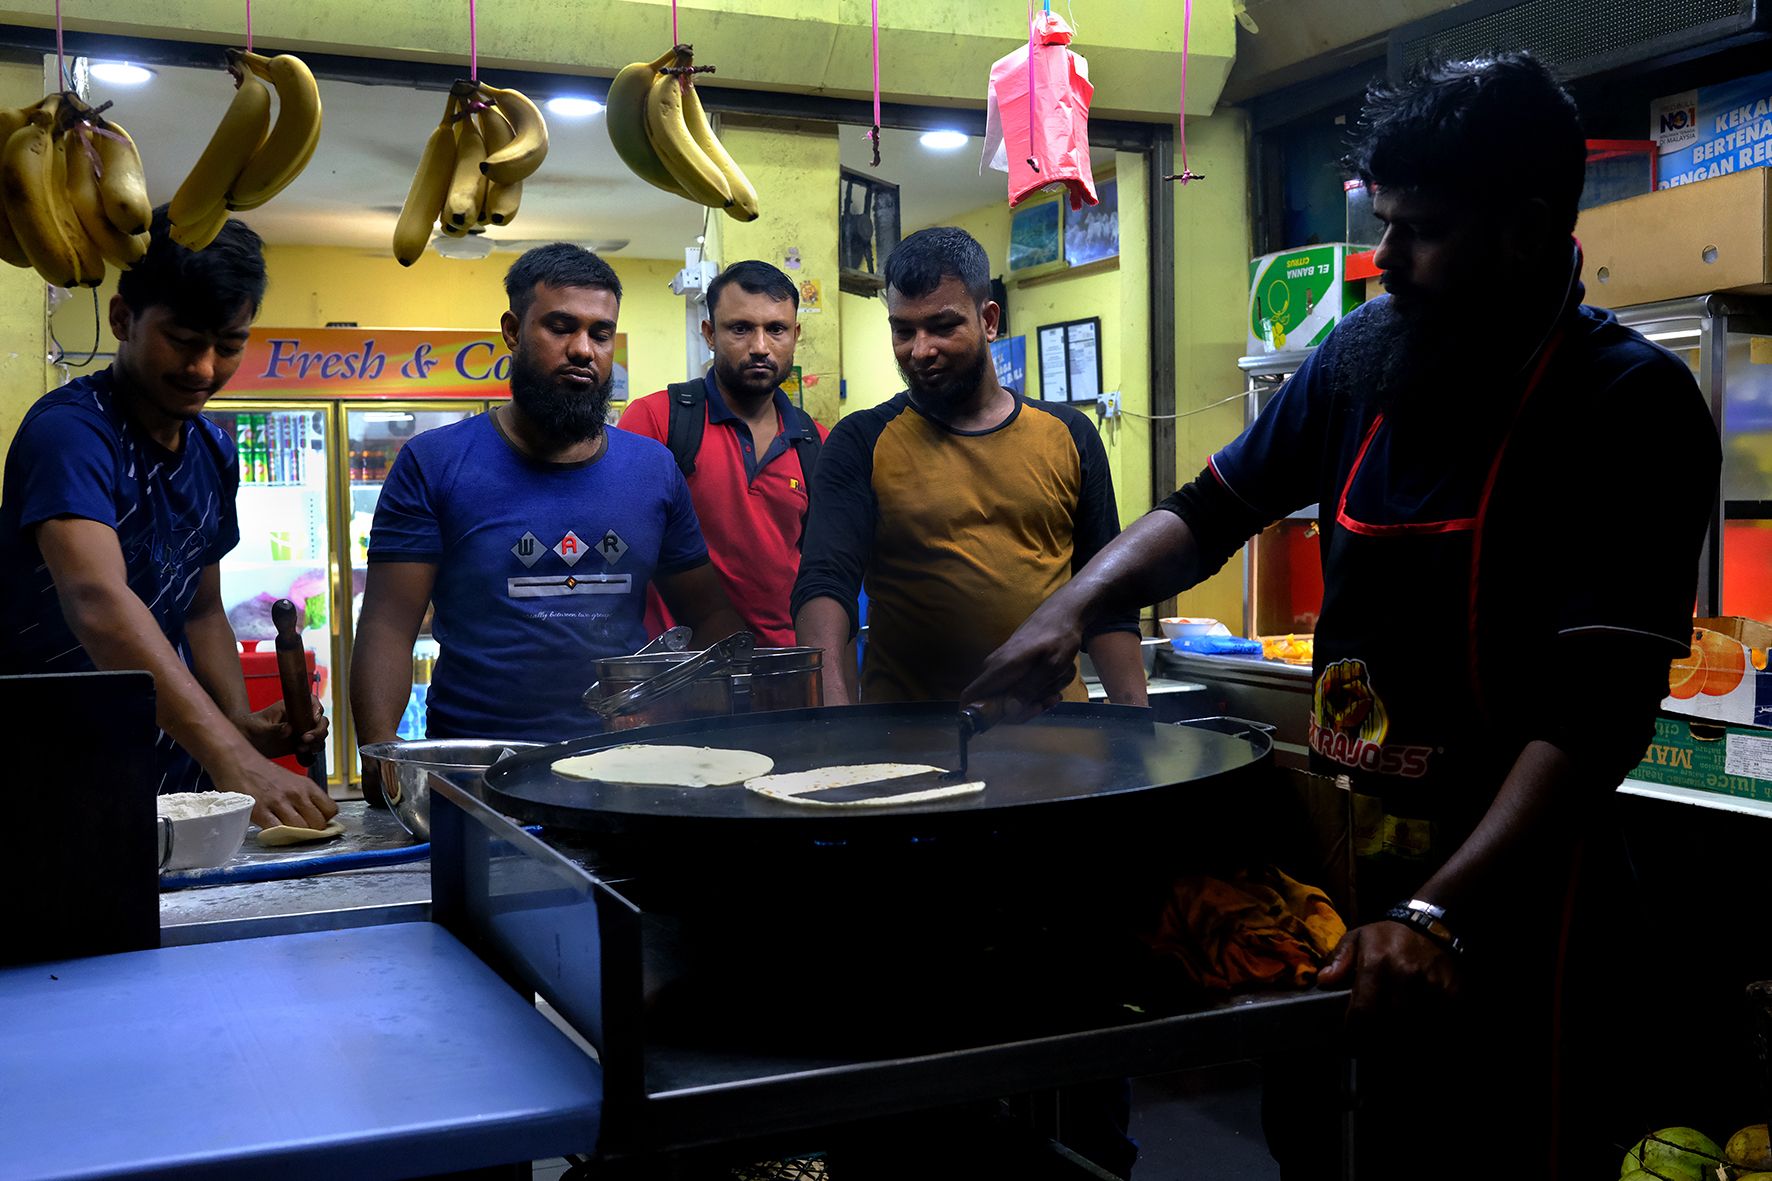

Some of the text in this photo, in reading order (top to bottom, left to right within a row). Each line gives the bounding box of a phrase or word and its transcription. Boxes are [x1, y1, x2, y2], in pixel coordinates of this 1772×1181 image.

[1286, 257, 1310, 268] CITRUS
[1287, 264, 1330, 279] EL BANNA
[258, 339, 386, 380] Fresh
[401, 343, 438, 379] &
[1706, 773, 1757, 799] juice
